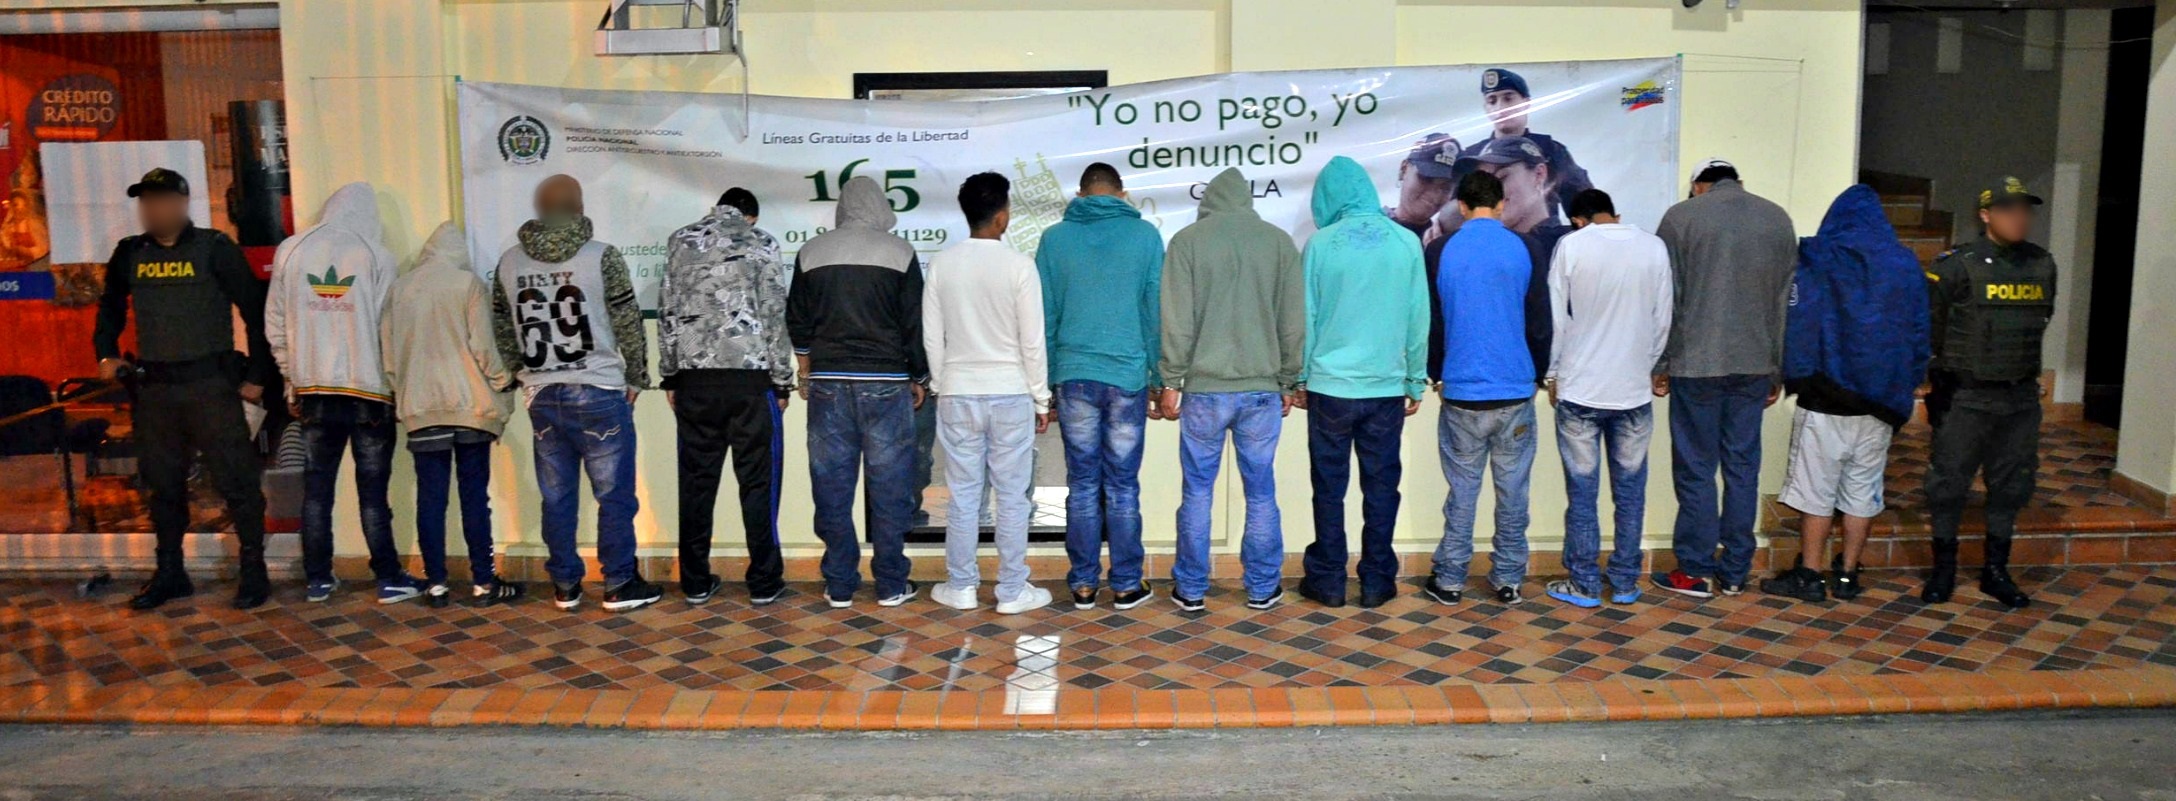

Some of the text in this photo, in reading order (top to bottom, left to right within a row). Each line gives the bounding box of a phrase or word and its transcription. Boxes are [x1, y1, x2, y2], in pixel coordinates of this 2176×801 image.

[42, 87, 113, 104] CRÉDITO
[44, 103, 115, 123] RÁPIDO
[1067, 92, 1378, 130] "Yo no pago, yo
[762, 130, 969, 144] Líneas Gratuitas de la Libertad
[1128, 131, 1318, 169] denuncio"
[1189, 178, 1283, 201] GLA
[785, 230, 807, 243] 01
[620, 241, 668, 256] ustede
[137, 262, 195, 278] POLICIA
[1987, 284, 2044, 300] POLICIA
[516, 284, 594, 368] 69
